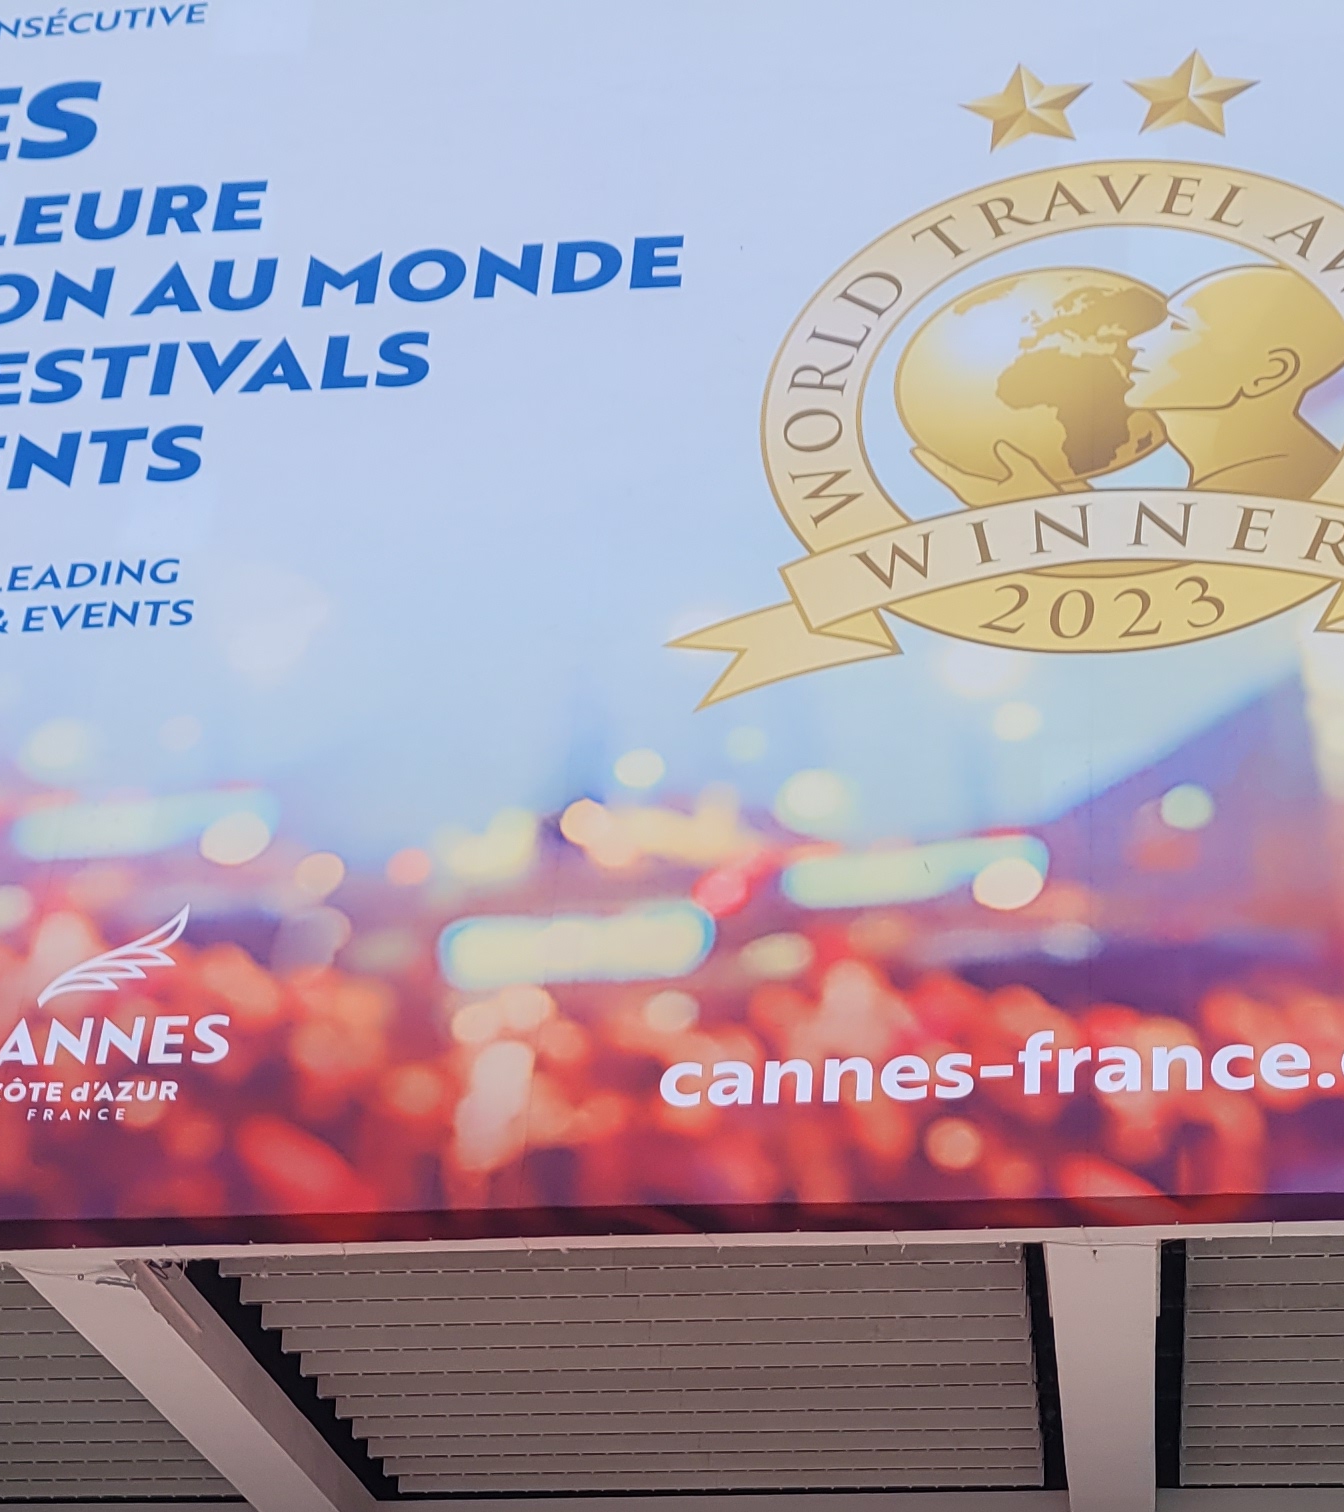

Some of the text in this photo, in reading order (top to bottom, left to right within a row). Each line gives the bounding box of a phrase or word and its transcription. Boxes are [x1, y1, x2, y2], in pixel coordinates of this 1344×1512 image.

[130, 256, 280, 317] AU
[300, 234, 685, 309] MONDE
[784, 268, 904, 530] WORLD
[911, 172, 1250, 263] TRAVEL
[20, 598, 195, 634] EVENTS
[979, 574, 1227, 640] 2023
[26, 1108, 126, 1121] FRANCE
[70, 1080, 179, 1102] d'AZUR
